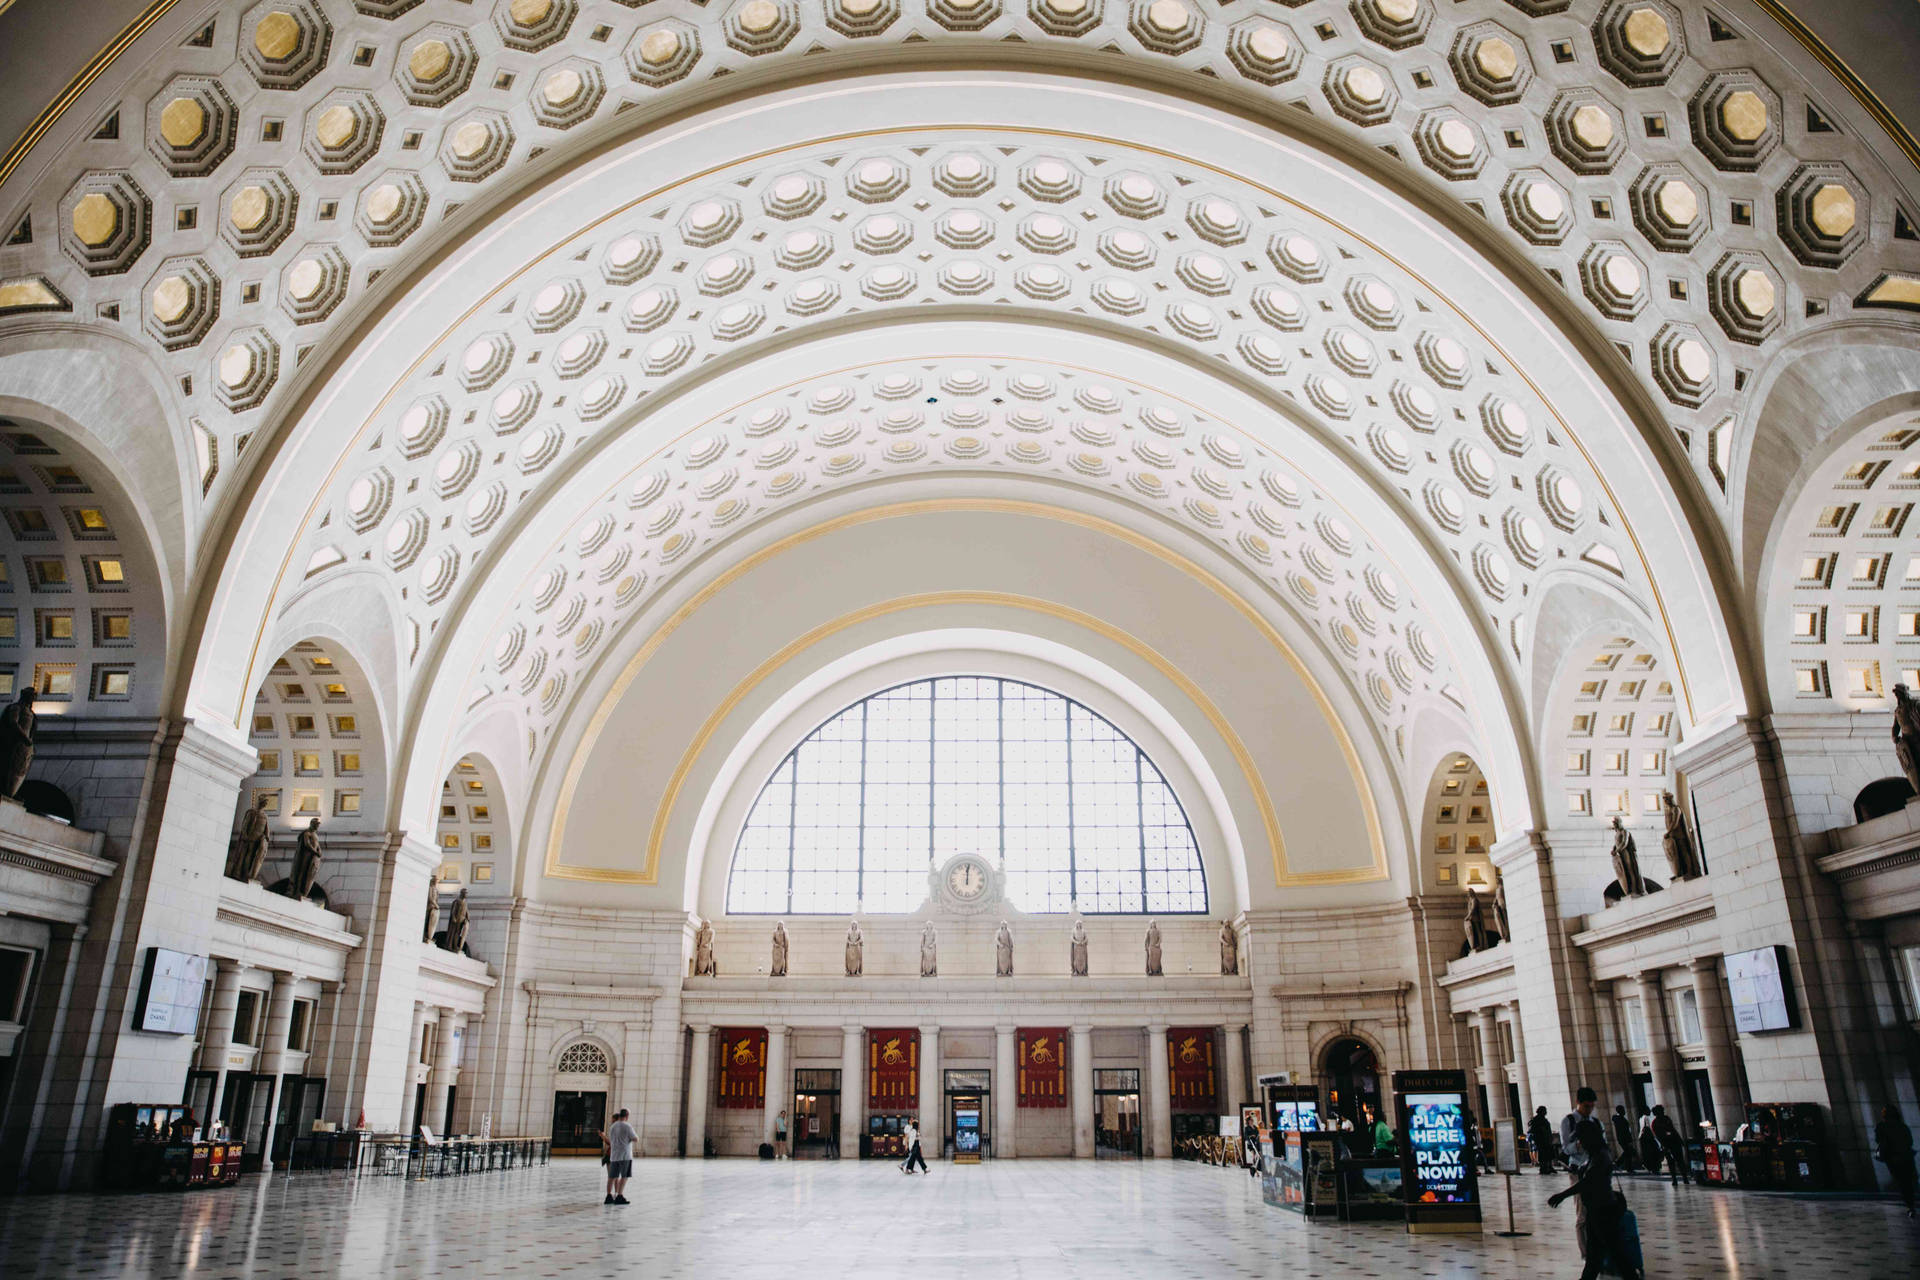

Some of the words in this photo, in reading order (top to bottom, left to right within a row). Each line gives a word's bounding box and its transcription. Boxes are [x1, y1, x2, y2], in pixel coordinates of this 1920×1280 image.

[1413, 1114, 1456, 1128] PLAY
[1414, 1129, 1459, 1143] HERE
[1416, 1150, 1460, 1165] PLAY
[1417, 1166, 1464, 1180] NOW!
